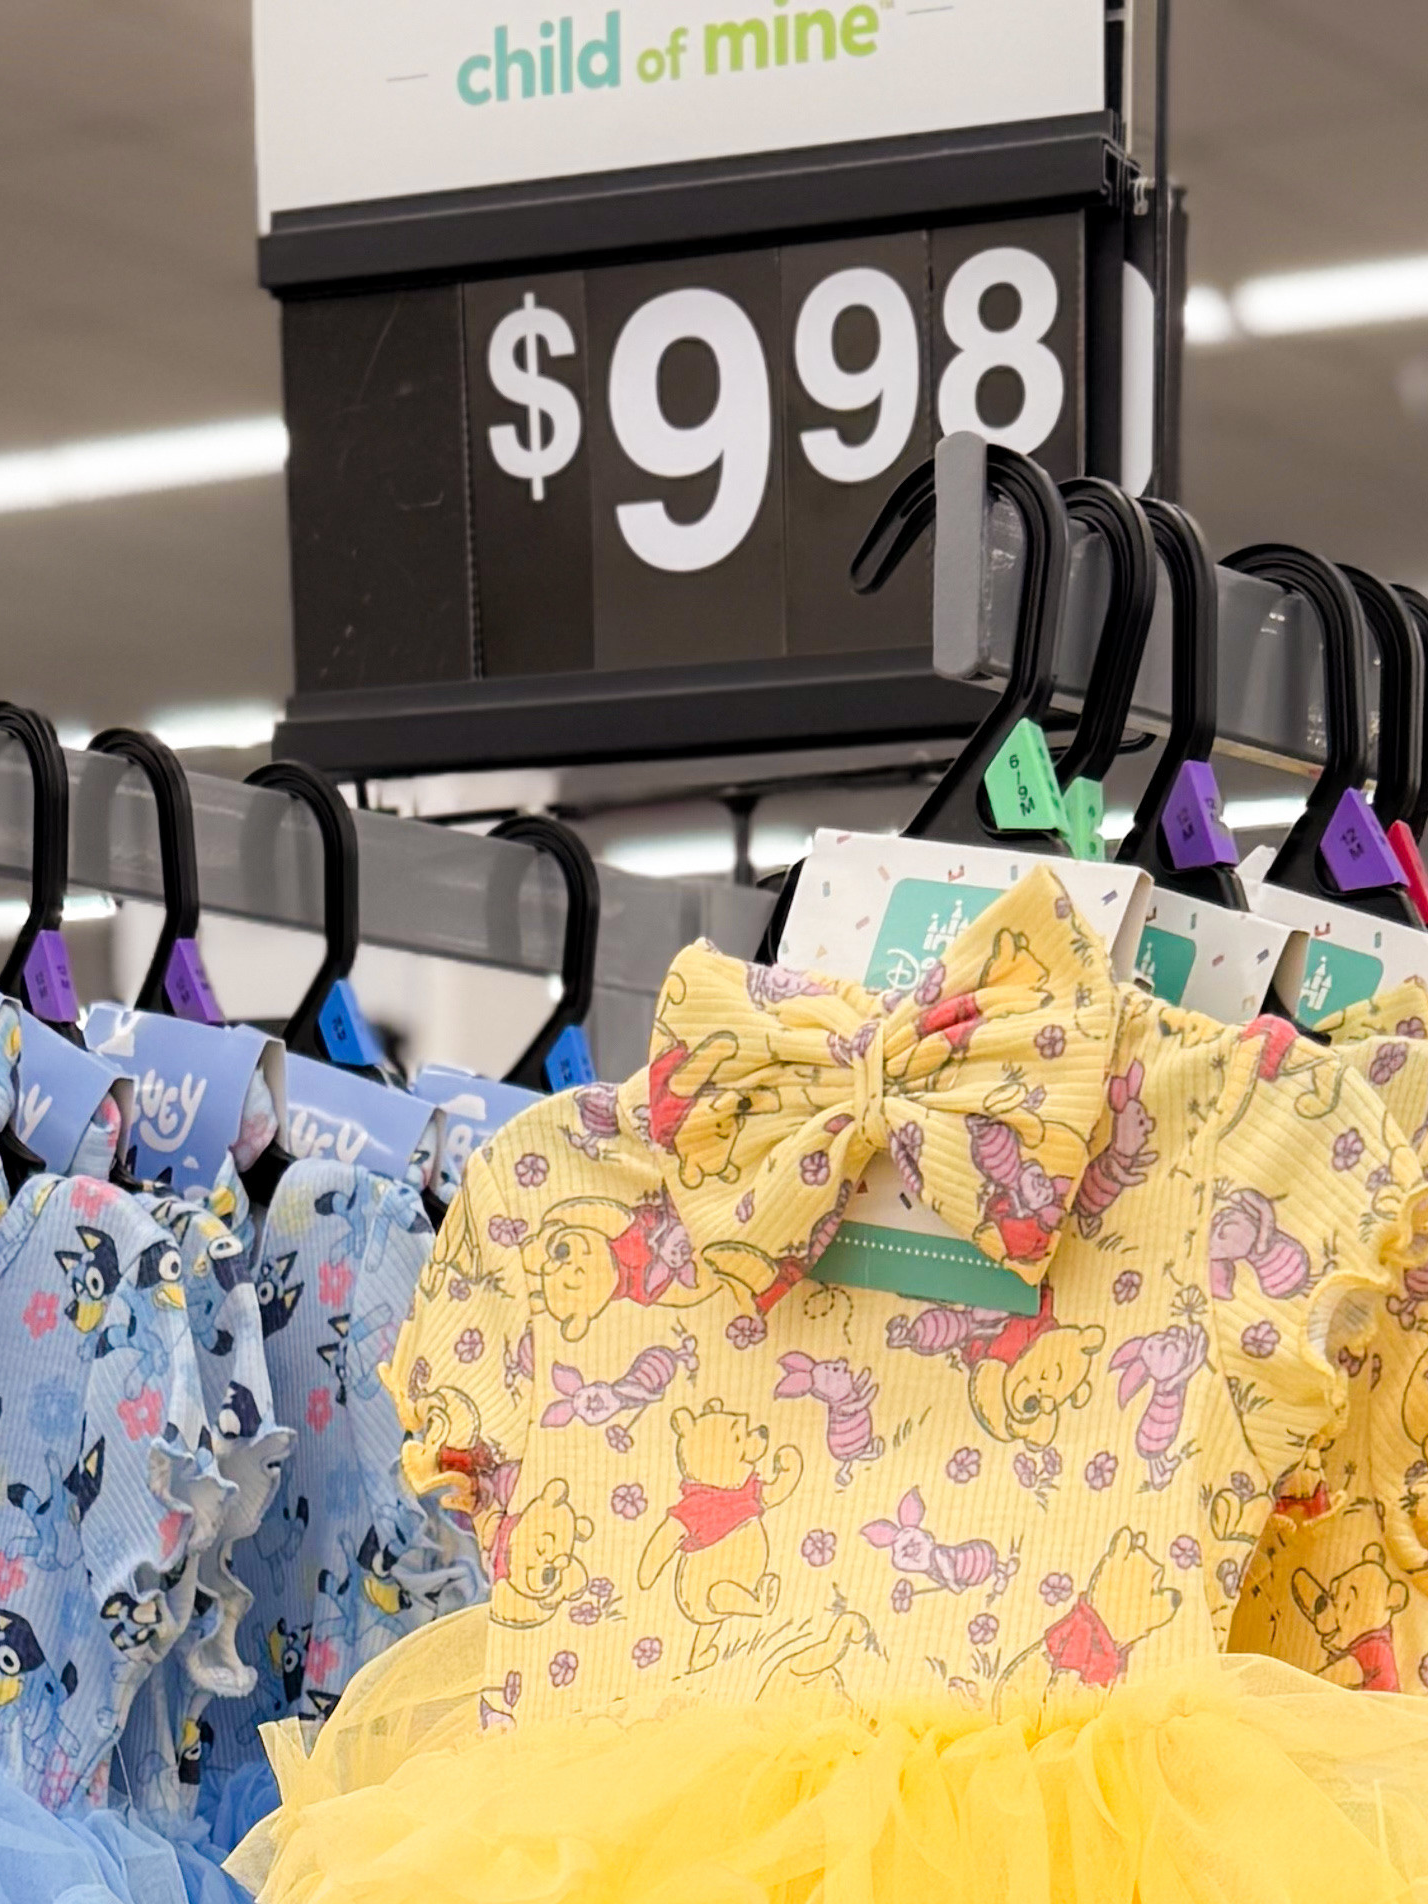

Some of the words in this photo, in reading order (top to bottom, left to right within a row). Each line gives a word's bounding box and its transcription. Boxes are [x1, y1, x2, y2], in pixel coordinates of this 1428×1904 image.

[456, 9, 621, 106] child
[636, 26, 689, 84] of
[704, 0, 880, 76] mine
[133, 1068, 208, 1154] UEY
